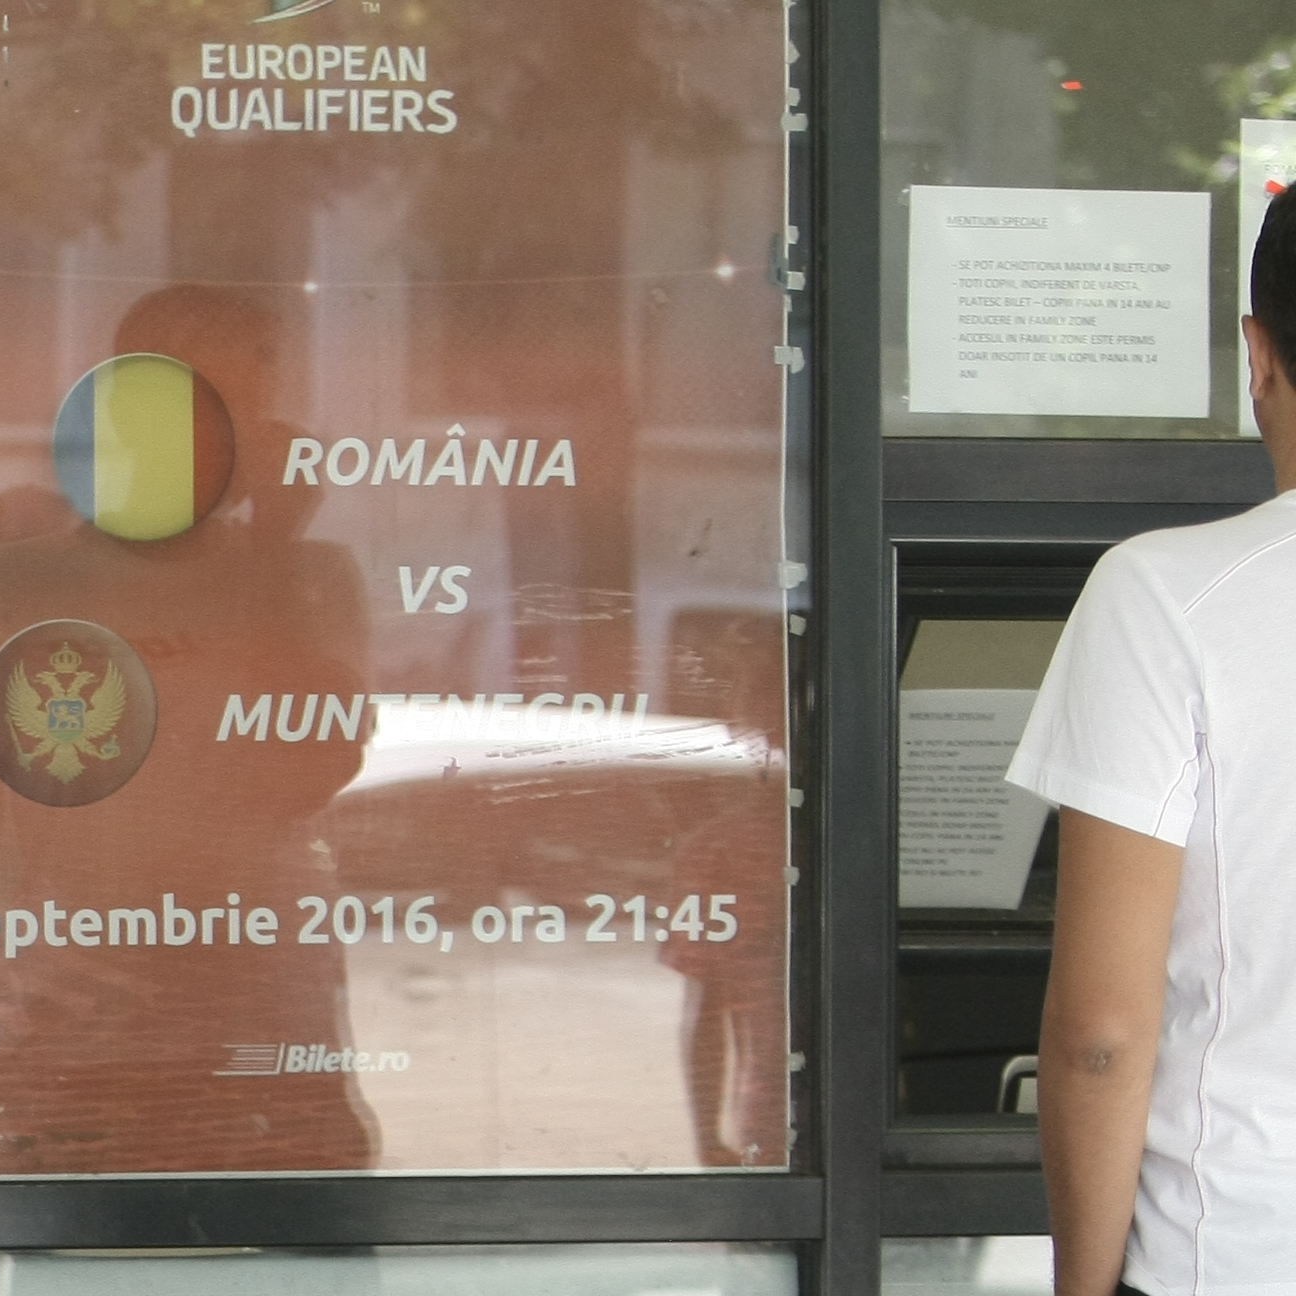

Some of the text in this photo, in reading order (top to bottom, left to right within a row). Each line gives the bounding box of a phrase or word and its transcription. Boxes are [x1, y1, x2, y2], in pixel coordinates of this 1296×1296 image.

[201, 43, 427, 82] EUROPEAN
[171, 86, 458, 138] QUALIFIERS
[282, 423, 577, 487] ROMÂNIA
[398, 565, 472, 615] VS
[216, 692, 649, 742] MUNTENEGRU
[297, 894, 455, 953] 2016,
[472, 904, 565, 943] ora
[585, 893, 738, 943] 21:45
[284, 1044, 410, 1074] Bilete.ro
